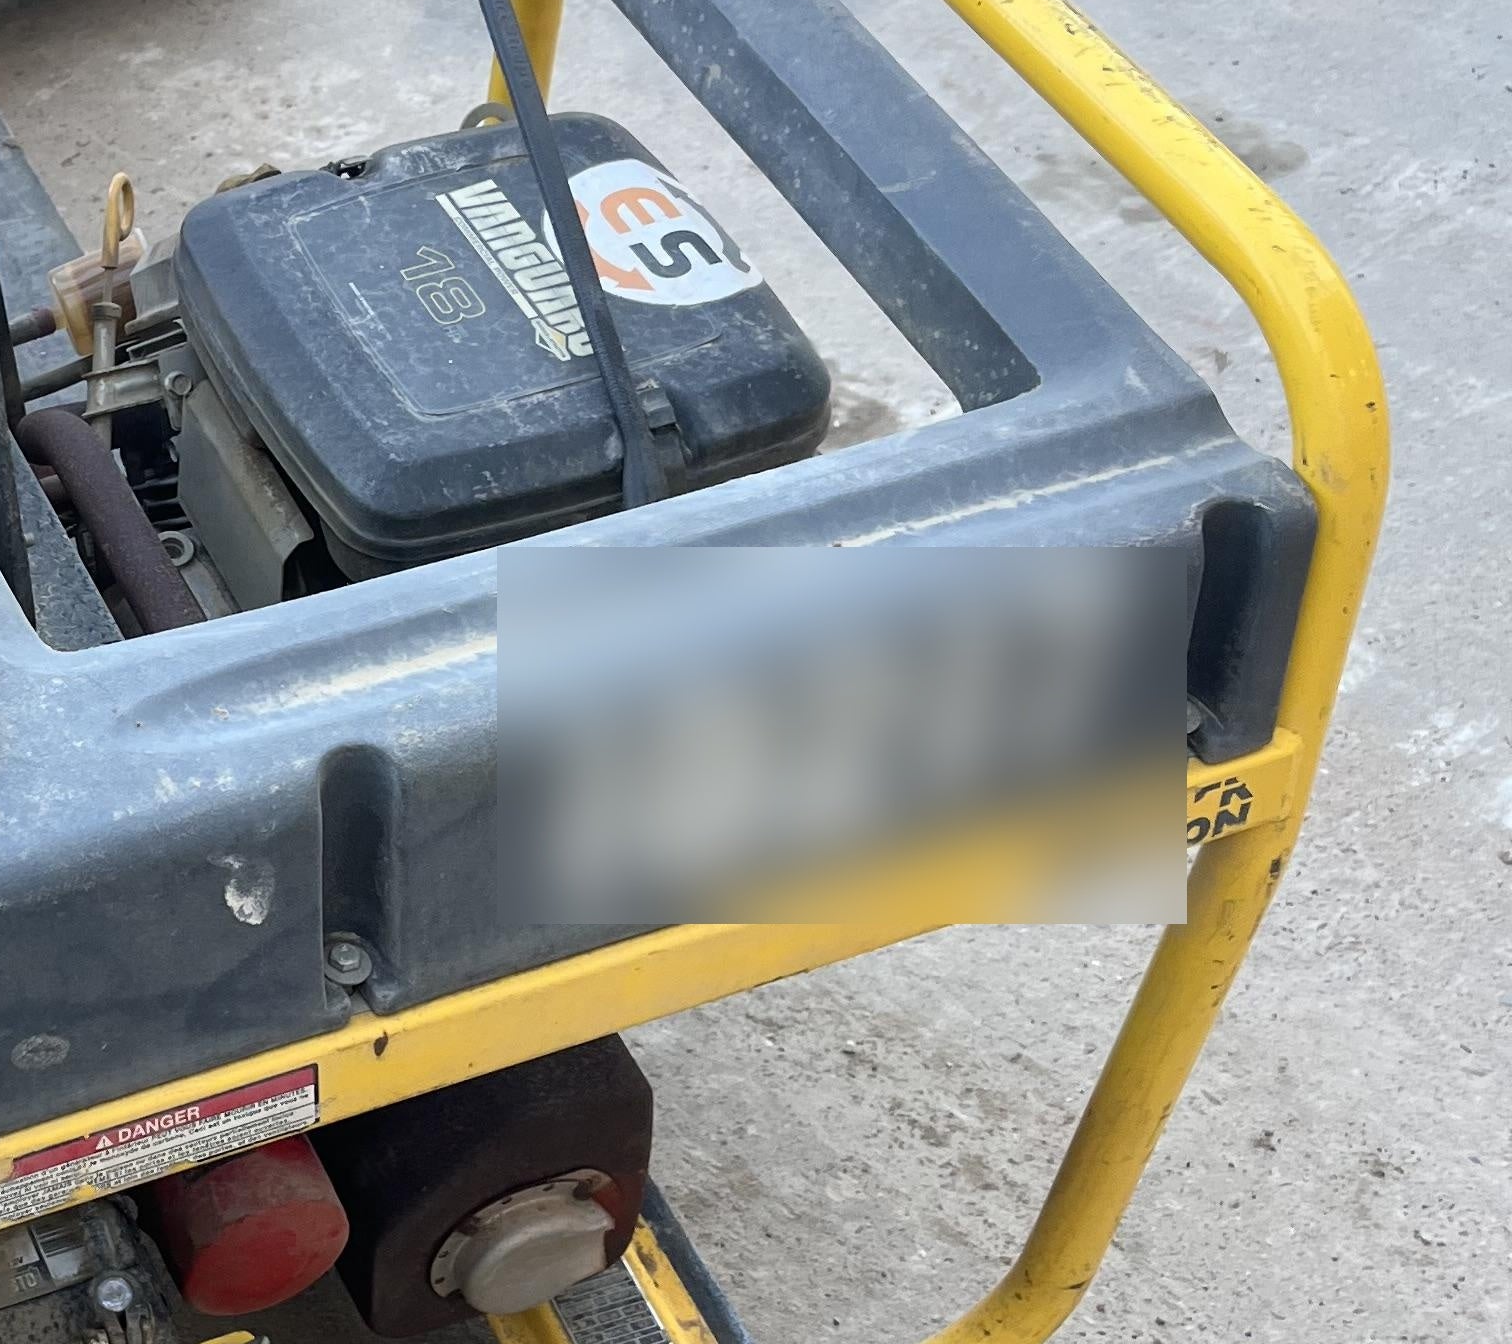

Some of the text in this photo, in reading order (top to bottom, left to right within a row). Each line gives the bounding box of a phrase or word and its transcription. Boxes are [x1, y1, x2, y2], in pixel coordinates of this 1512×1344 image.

[600, 187, 723, 279] ES
[401, 246, 486, 326] 18
[118, 1106, 200, 1143] DANGER
